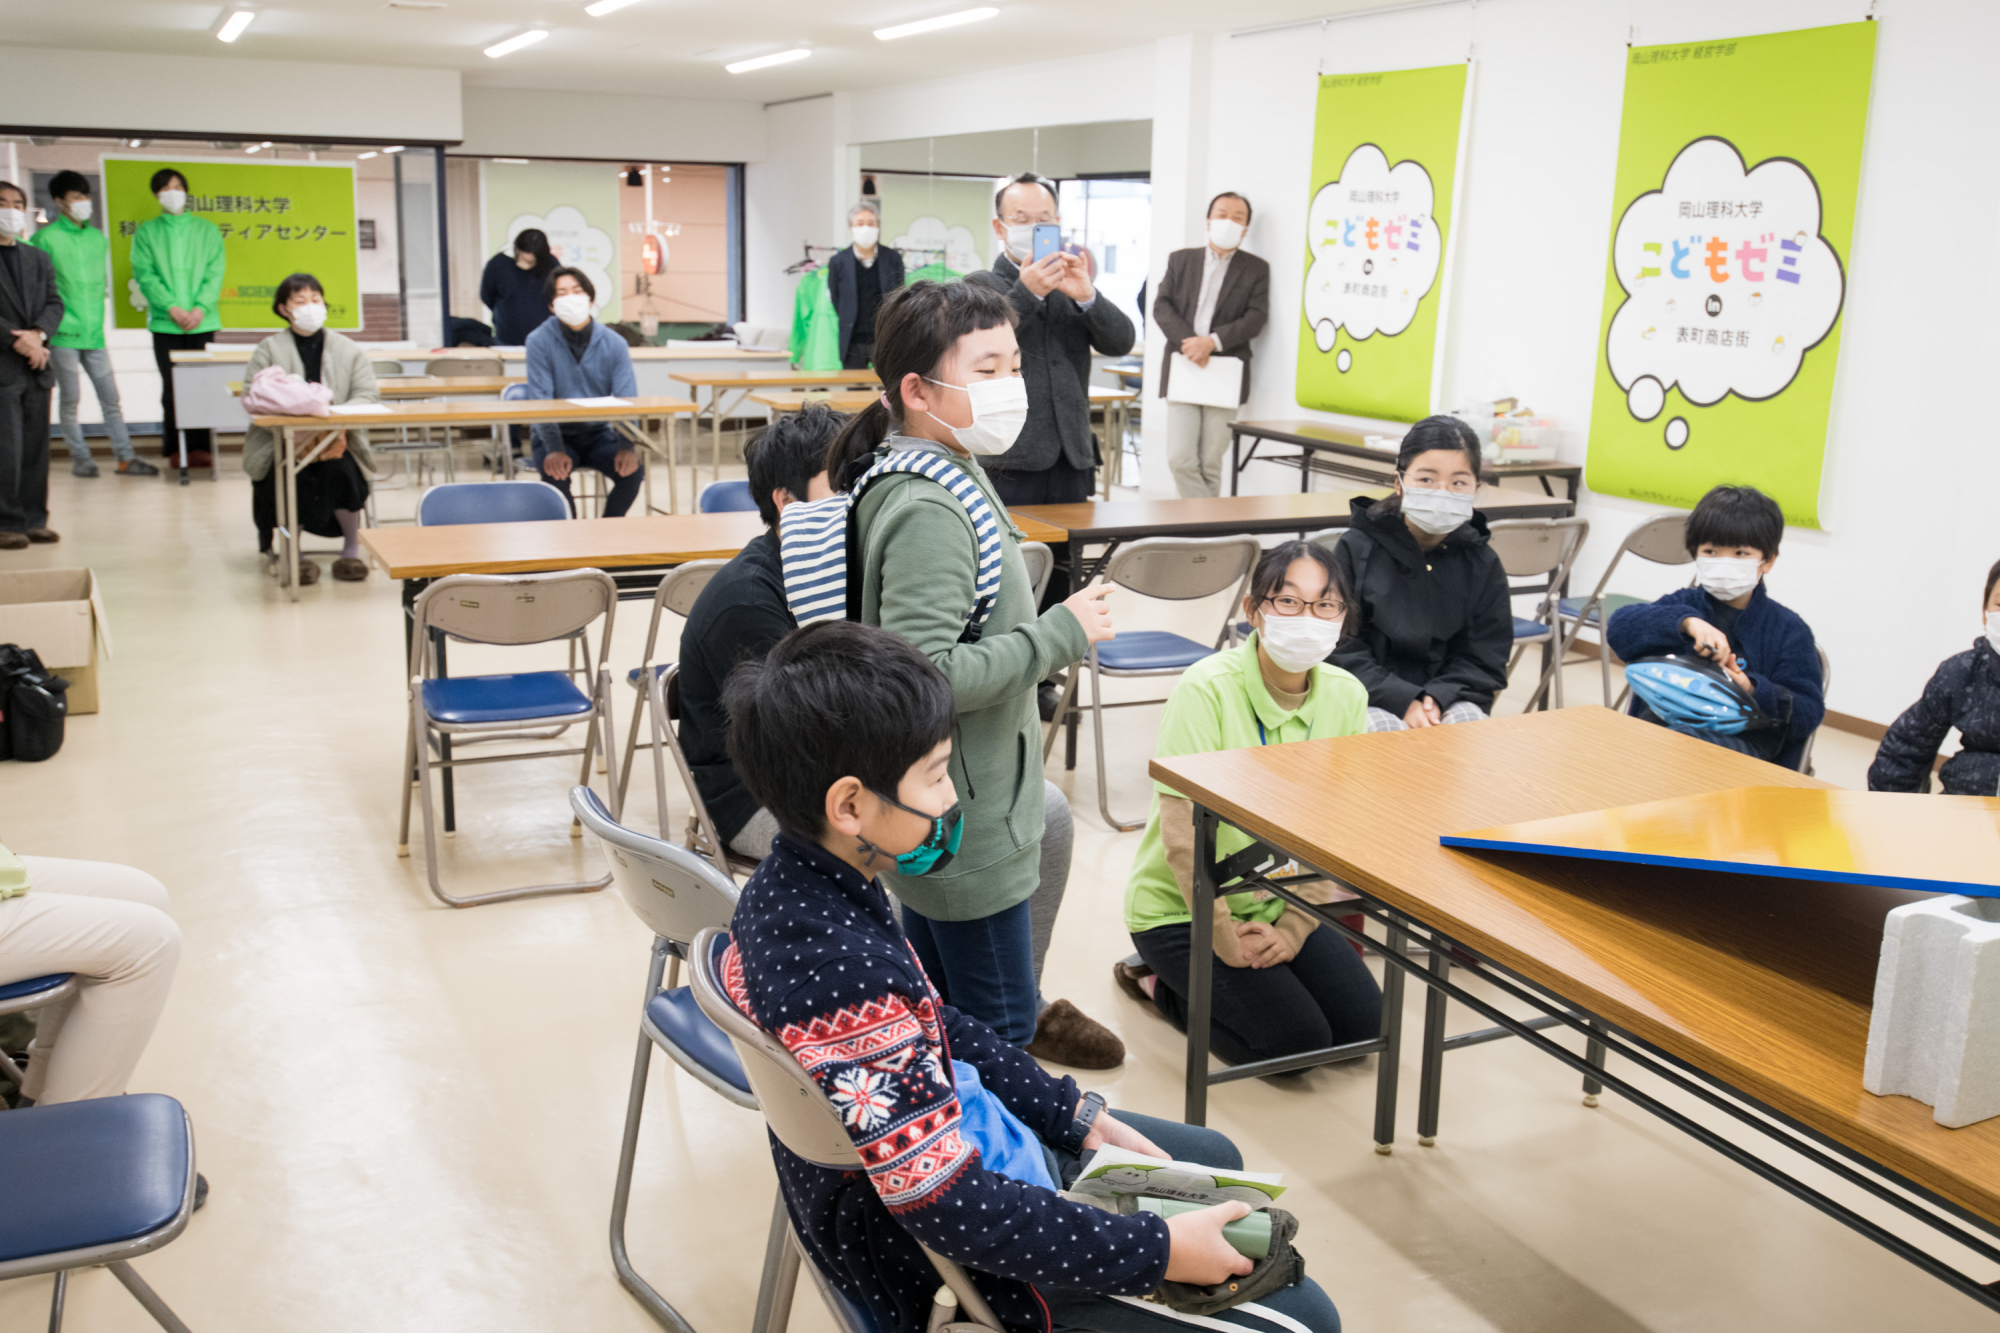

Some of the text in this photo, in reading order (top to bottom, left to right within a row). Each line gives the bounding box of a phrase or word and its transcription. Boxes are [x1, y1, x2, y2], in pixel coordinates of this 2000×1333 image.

[1678, 201, 1763, 219] 岡山理科大学
[1323, 214, 1422, 252] こどもゼミ
[1641, 232, 1802, 285] こどもゼミ
[1677, 327, 1750, 348] 表町商店街
[1144, 1186, 1209, 1200] 岡山理科大学
